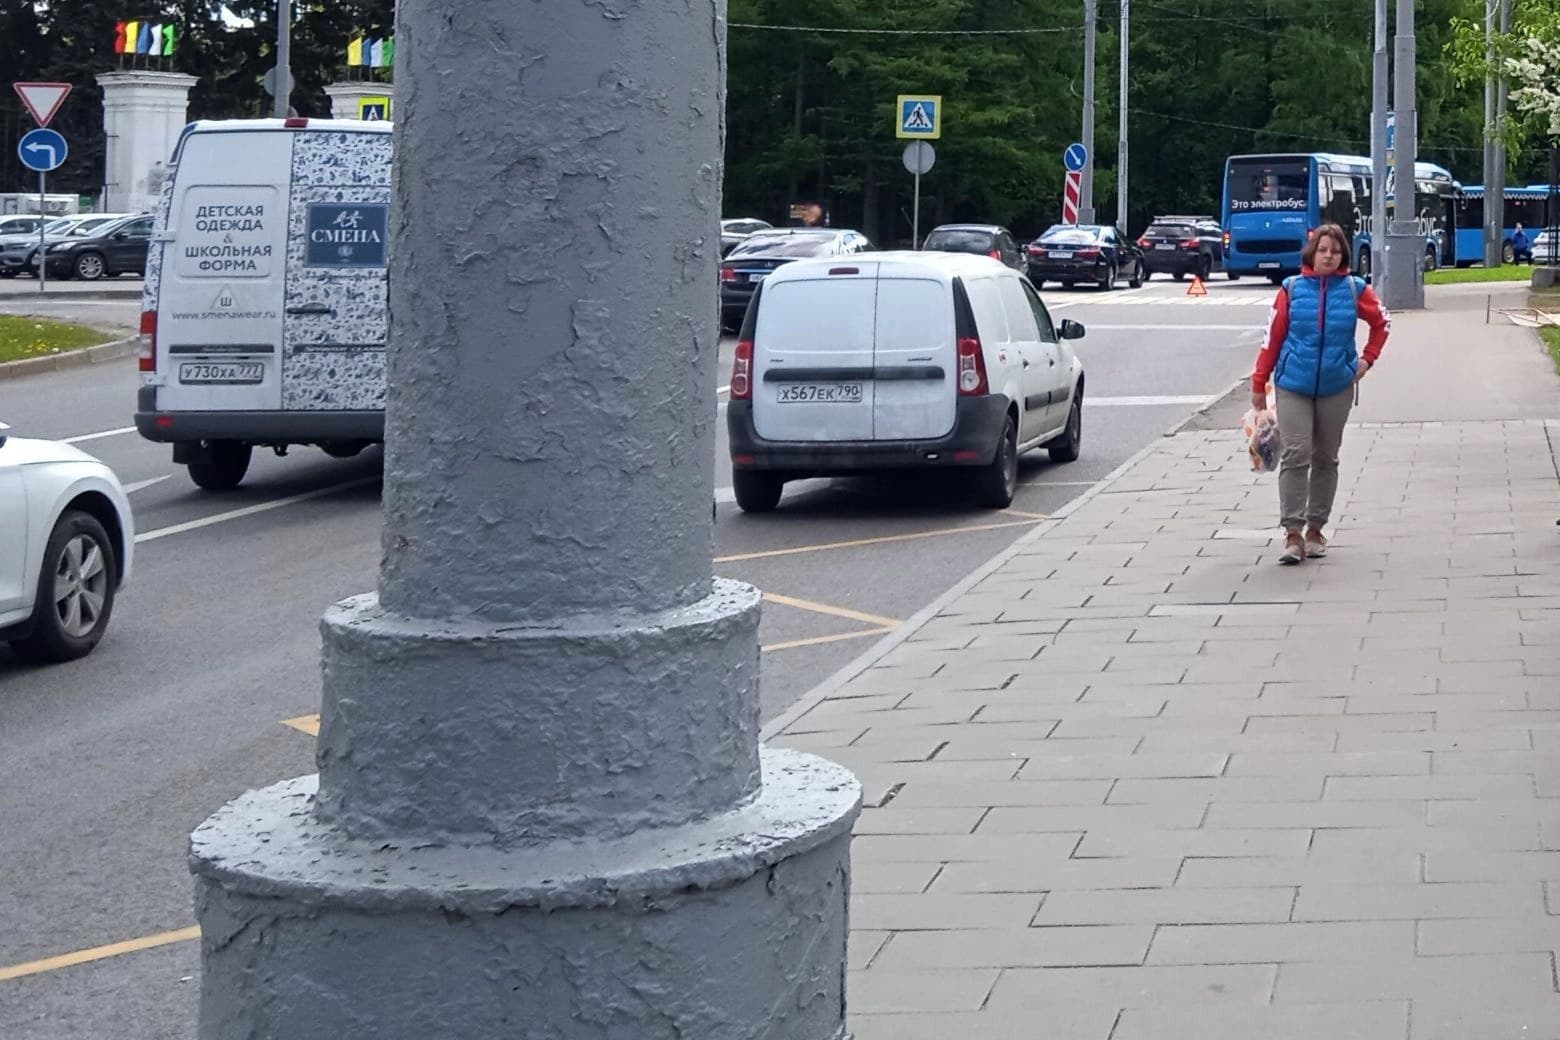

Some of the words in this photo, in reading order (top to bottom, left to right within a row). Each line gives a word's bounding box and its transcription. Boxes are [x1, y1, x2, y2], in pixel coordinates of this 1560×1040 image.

[1231, 199, 1249, 209] Это
[196, 205, 264, 218] ДЕТСКАЯ
[196, 219, 263, 232] ОДЕЖДА
[311, 229, 381, 243] СМЕНА
[185, 245, 272, 258] ШКОЛЬНАЯ
[199, 259, 257, 271] ФОРМА
[172, 310, 277, 320] www.smenawear.ru
